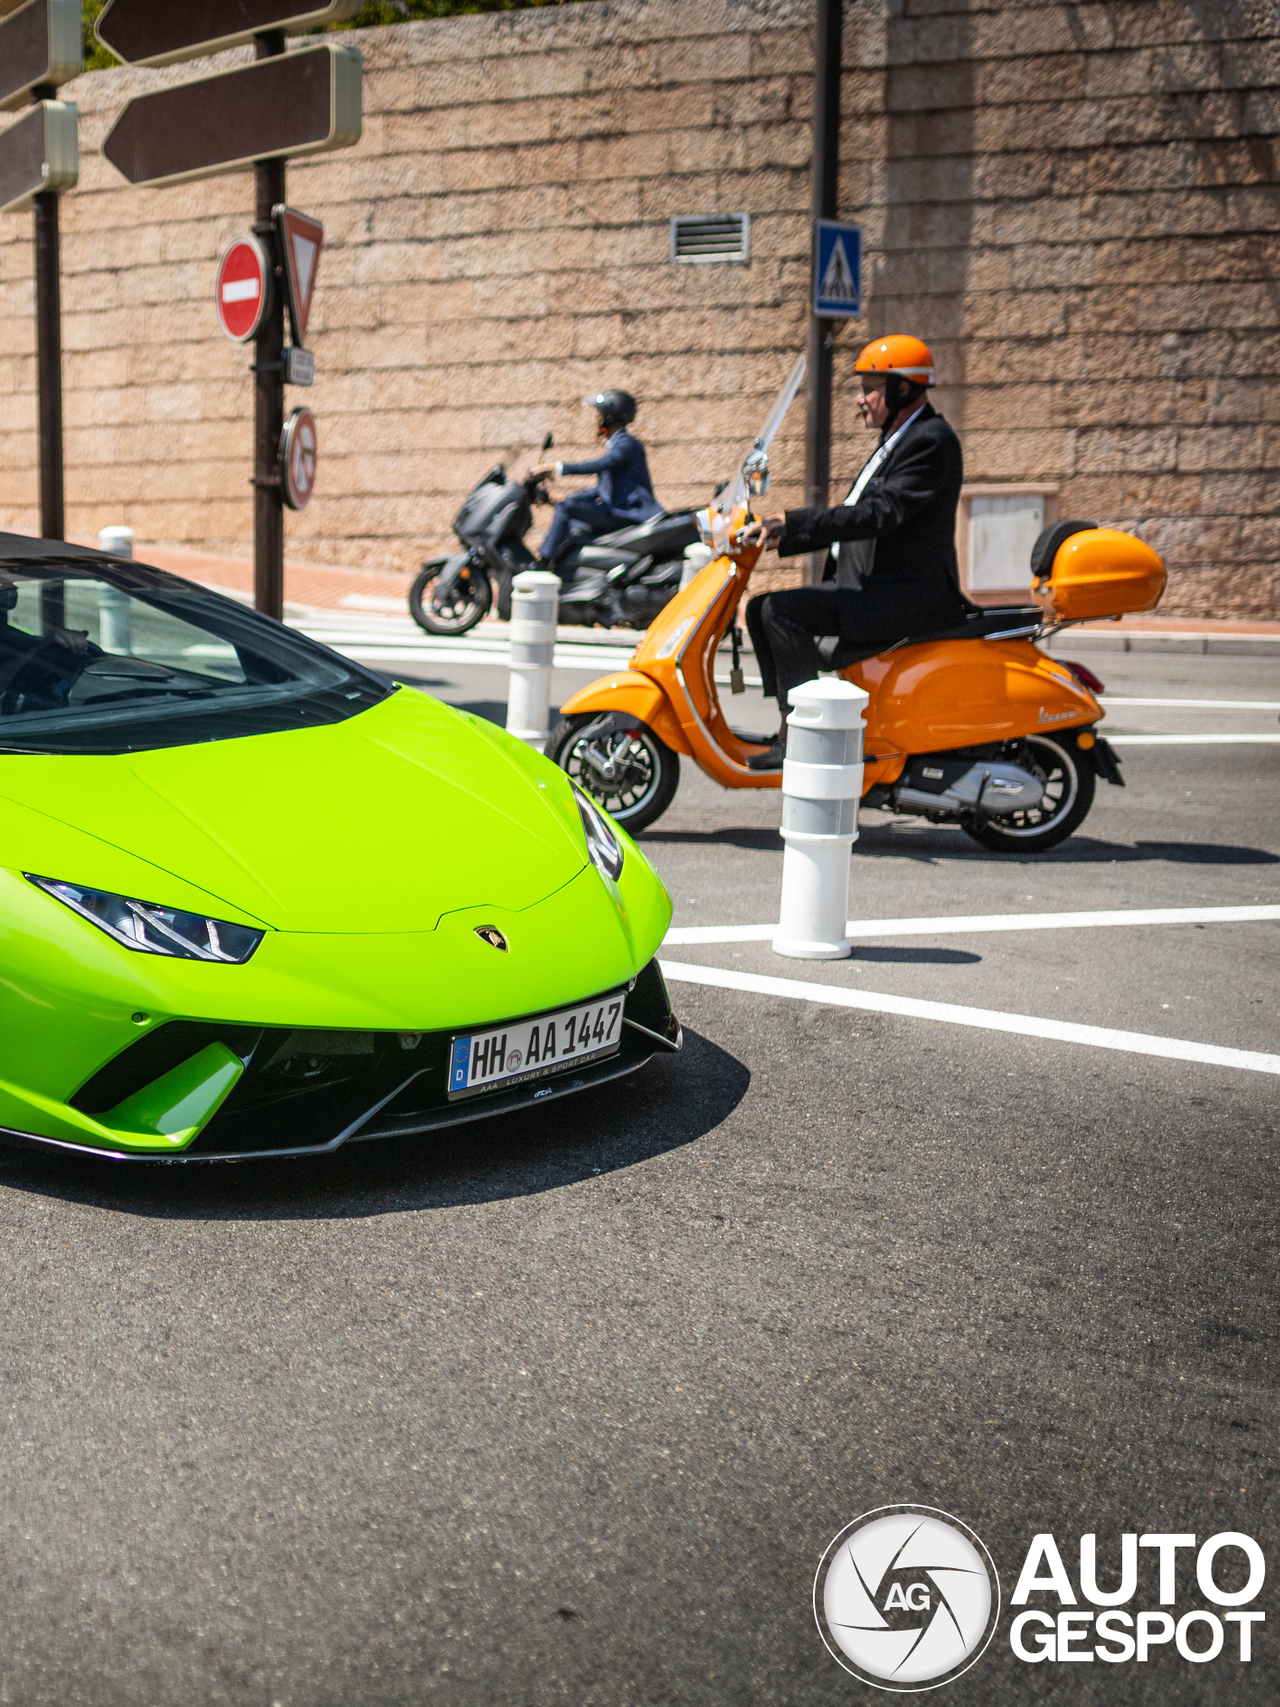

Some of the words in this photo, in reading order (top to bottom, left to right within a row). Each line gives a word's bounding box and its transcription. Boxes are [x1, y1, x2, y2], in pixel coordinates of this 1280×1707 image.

[470, 1034, 508, 1081] HH
[525, 1021, 557, 1066] AA
[562, 1002, 621, 1055] 1447
[456, 1069, 464, 1082] D
[480, 1083, 499, 1093] AAA
[506, 1070, 541, 1086] LUXURY
[542, 1068, 549, 1076] &
[551, 1058, 579, 1073] SPORT
[580, 1053, 596, 1064] CAR
